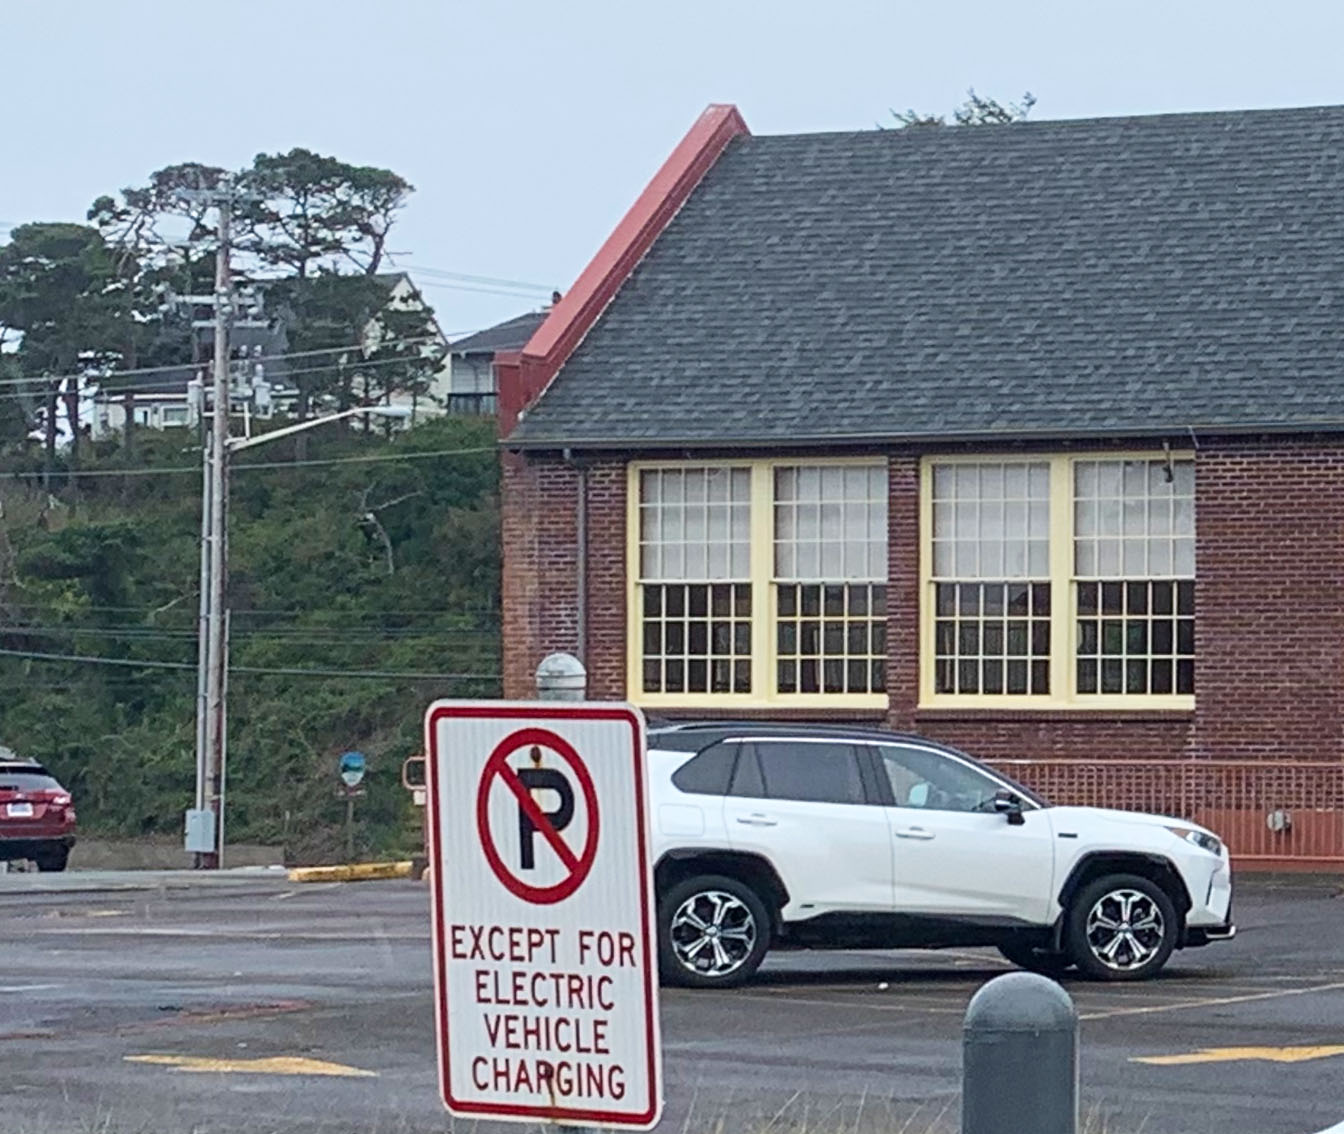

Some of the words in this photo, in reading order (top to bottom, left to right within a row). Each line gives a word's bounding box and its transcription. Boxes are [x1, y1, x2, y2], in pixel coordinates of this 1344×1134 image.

[451, 925, 560, 964] EXCEPT
[578, 931, 636, 968] FOR
[475, 970, 615, 1012] ELECTRIC
[483, 1013, 609, 1055] VEHICLE
[472, 1056, 625, 1100] CHARGING
